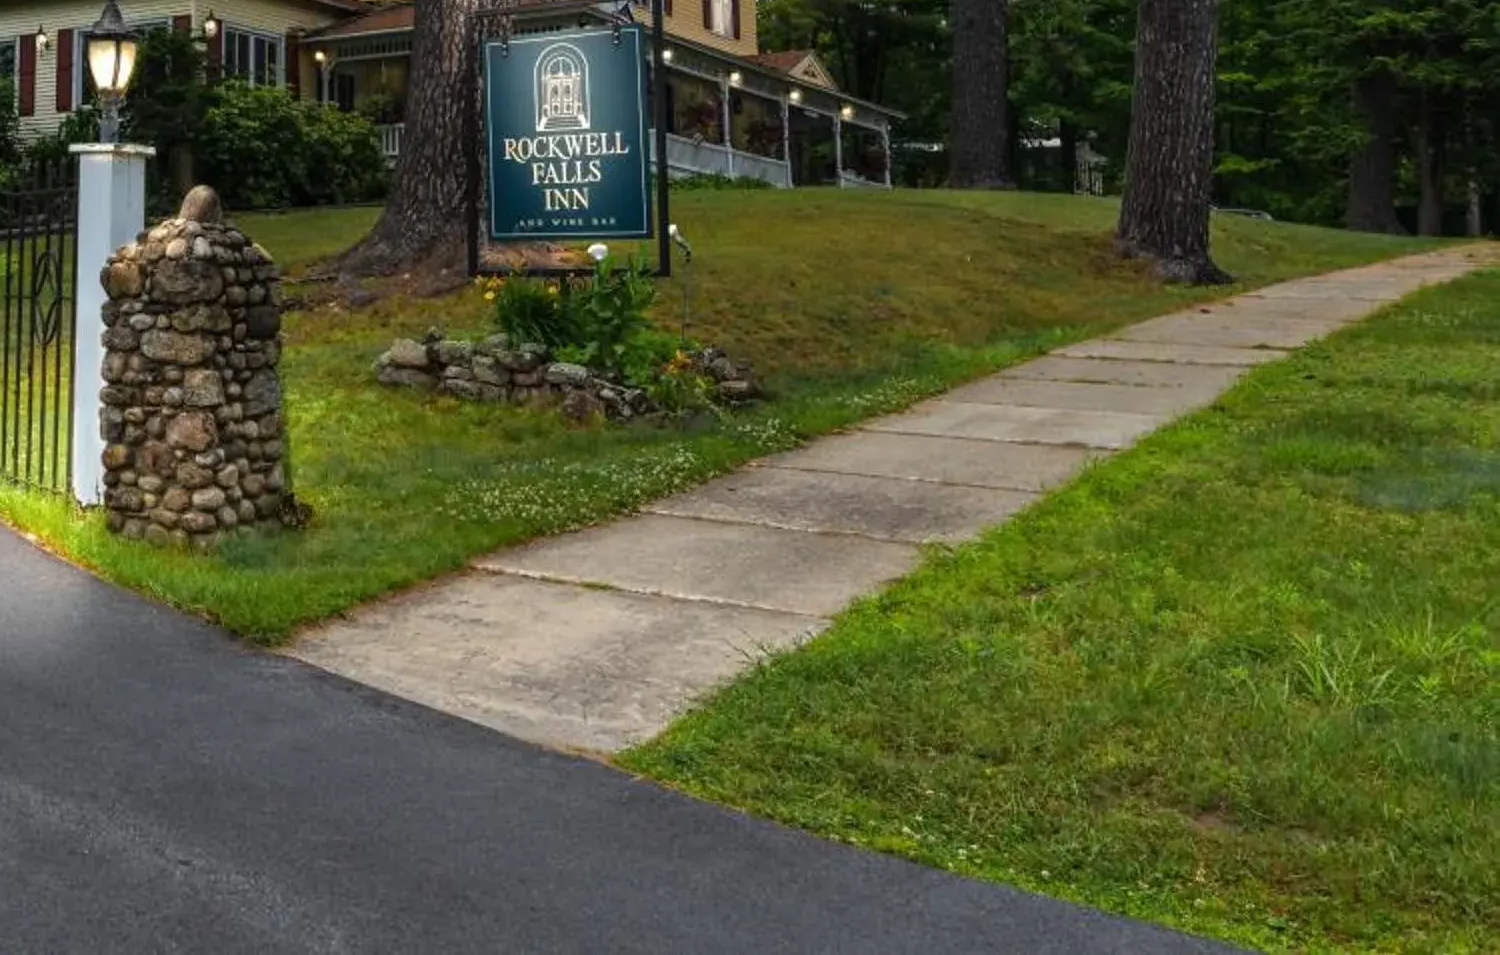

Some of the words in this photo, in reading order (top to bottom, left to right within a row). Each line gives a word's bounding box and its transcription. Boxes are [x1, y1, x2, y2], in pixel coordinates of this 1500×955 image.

[504, 131, 629, 163] ROCKWELL
[532, 160, 601, 185] FALLS
[544, 188, 589, 211] INN
